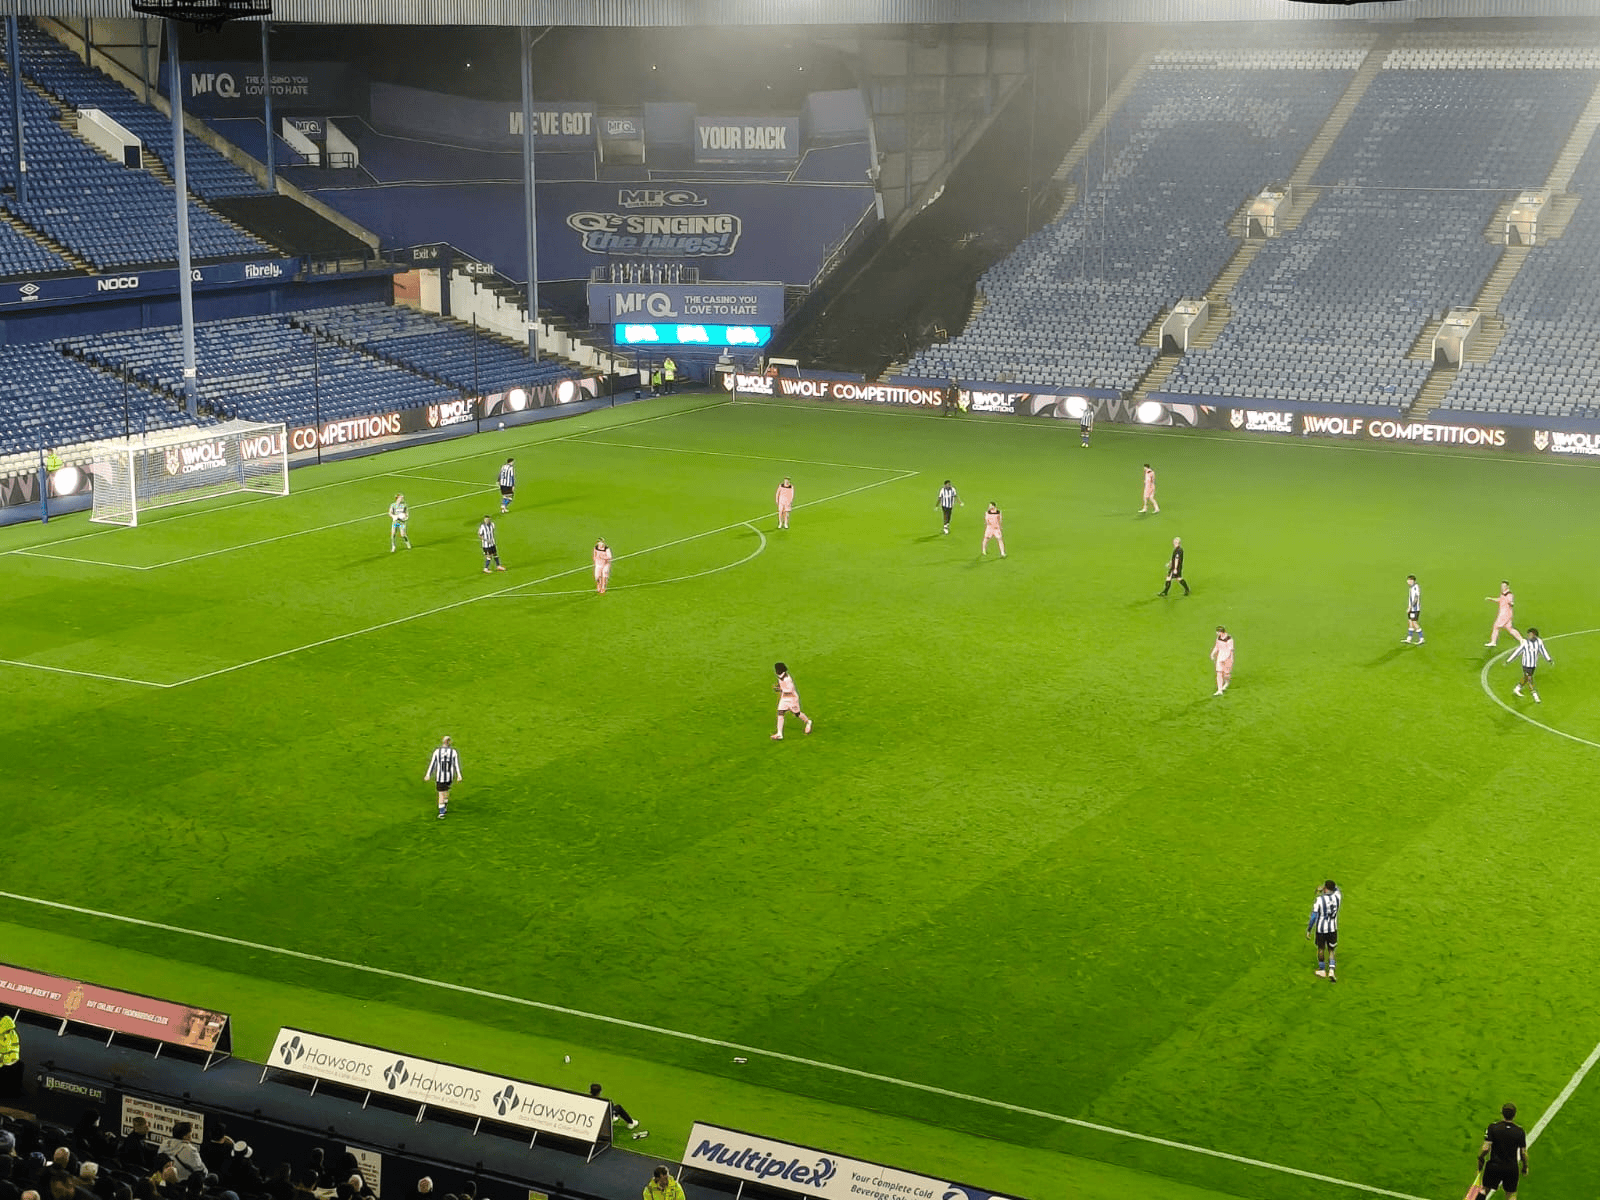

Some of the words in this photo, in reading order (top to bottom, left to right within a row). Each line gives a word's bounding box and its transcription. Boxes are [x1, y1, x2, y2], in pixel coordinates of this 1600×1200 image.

[191, 73, 240, 97] MrQ
[245, 76, 260, 84] THE
[261, 76, 290, 84] CSINO
[292, 76, 308, 84] YOU
[245, 86, 265, 95] LOV
[272, 86, 284, 95] TO
[285, 86, 308, 95] HATE
[561, 112, 593, 135] GOT
[700, 126, 742, 150] YOUR
[744, 126, 787, 150] BACK
[626, 216, 733, 235] SINGING
[586, 231, 639, 250] the
[640, 232, 730, 252] blues!
[413, 248, 430, 260] Exit
[475, 262, 494, 275] Exit
[97, 276, 139, 291] NOCO
[615, 292, 678, 318] MrQ
[684, 295, 701, 304] THE
[702, 295, 737, 304] CASINO
[738, 296, 757, 304] YOU
[684, 305, 711, 315] LOVE
[712, 305, 728, 315] TO
[730, 306, 757, 315] HATE
[781, 379, 829, 397] WOLF
[833, 383, 943, 406] COMPETITIONS
[972, 391, 1015, 406] WOLF
[440, 399, 473, 419] WOLF
[1245, 410, 1293, 426] WOLF
[293, 413, 400, 450] COMPETITIONS
[1303, 415, 1363, 435] WOLF
[1369, 420, 1506, 446] COMPETITIONS
[181, 441, 226, 464] WOLF
[305, 1047, 373, 1077] Hawsons
[410, 1072, 481, 1102] Hawsons
[520, 1097, 595, 1128] Hawsons
[691, 1140, 836, 1187] Multiplex
[851, 1171, 871, 1183] Your
[871, 1177, 912, 1193] Complete
[913, 1187, 934, 1199] Cold
